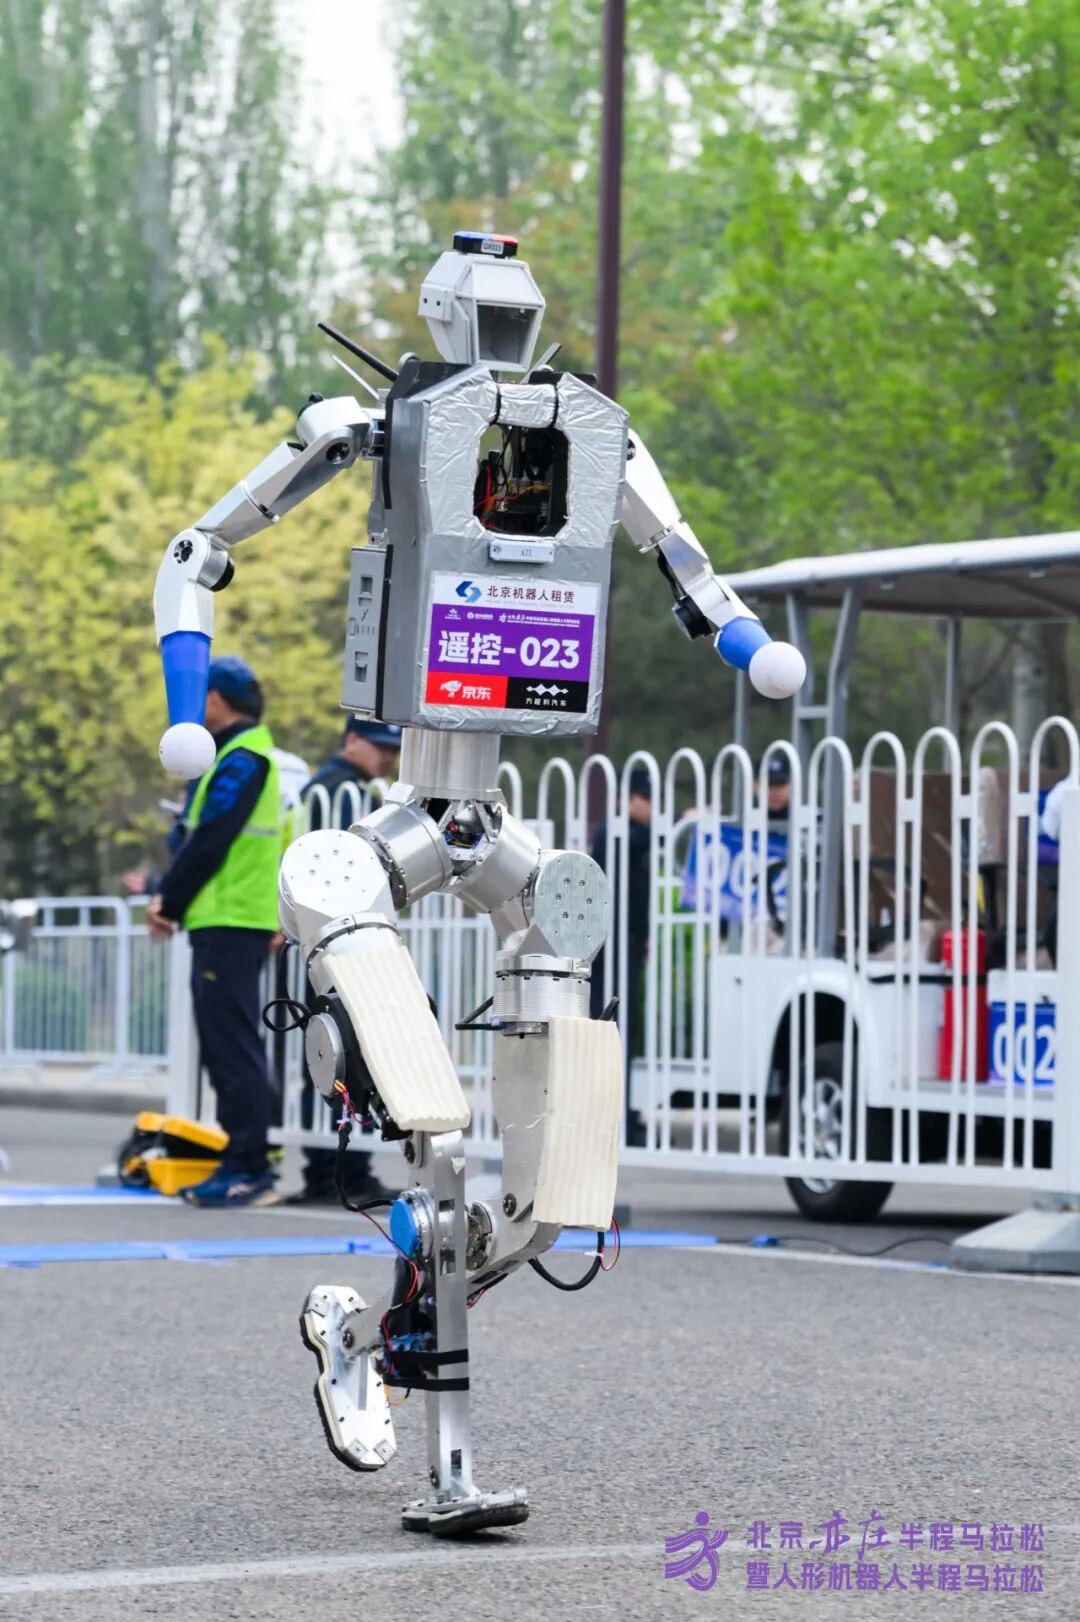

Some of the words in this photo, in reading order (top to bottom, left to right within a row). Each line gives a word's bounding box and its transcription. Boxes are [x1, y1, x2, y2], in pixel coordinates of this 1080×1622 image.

[487, 585, 575, 604] 北京机器人租赁
[438, 630, 580, 669] 遥控-023
[462, 686, 492, 700] 京东
